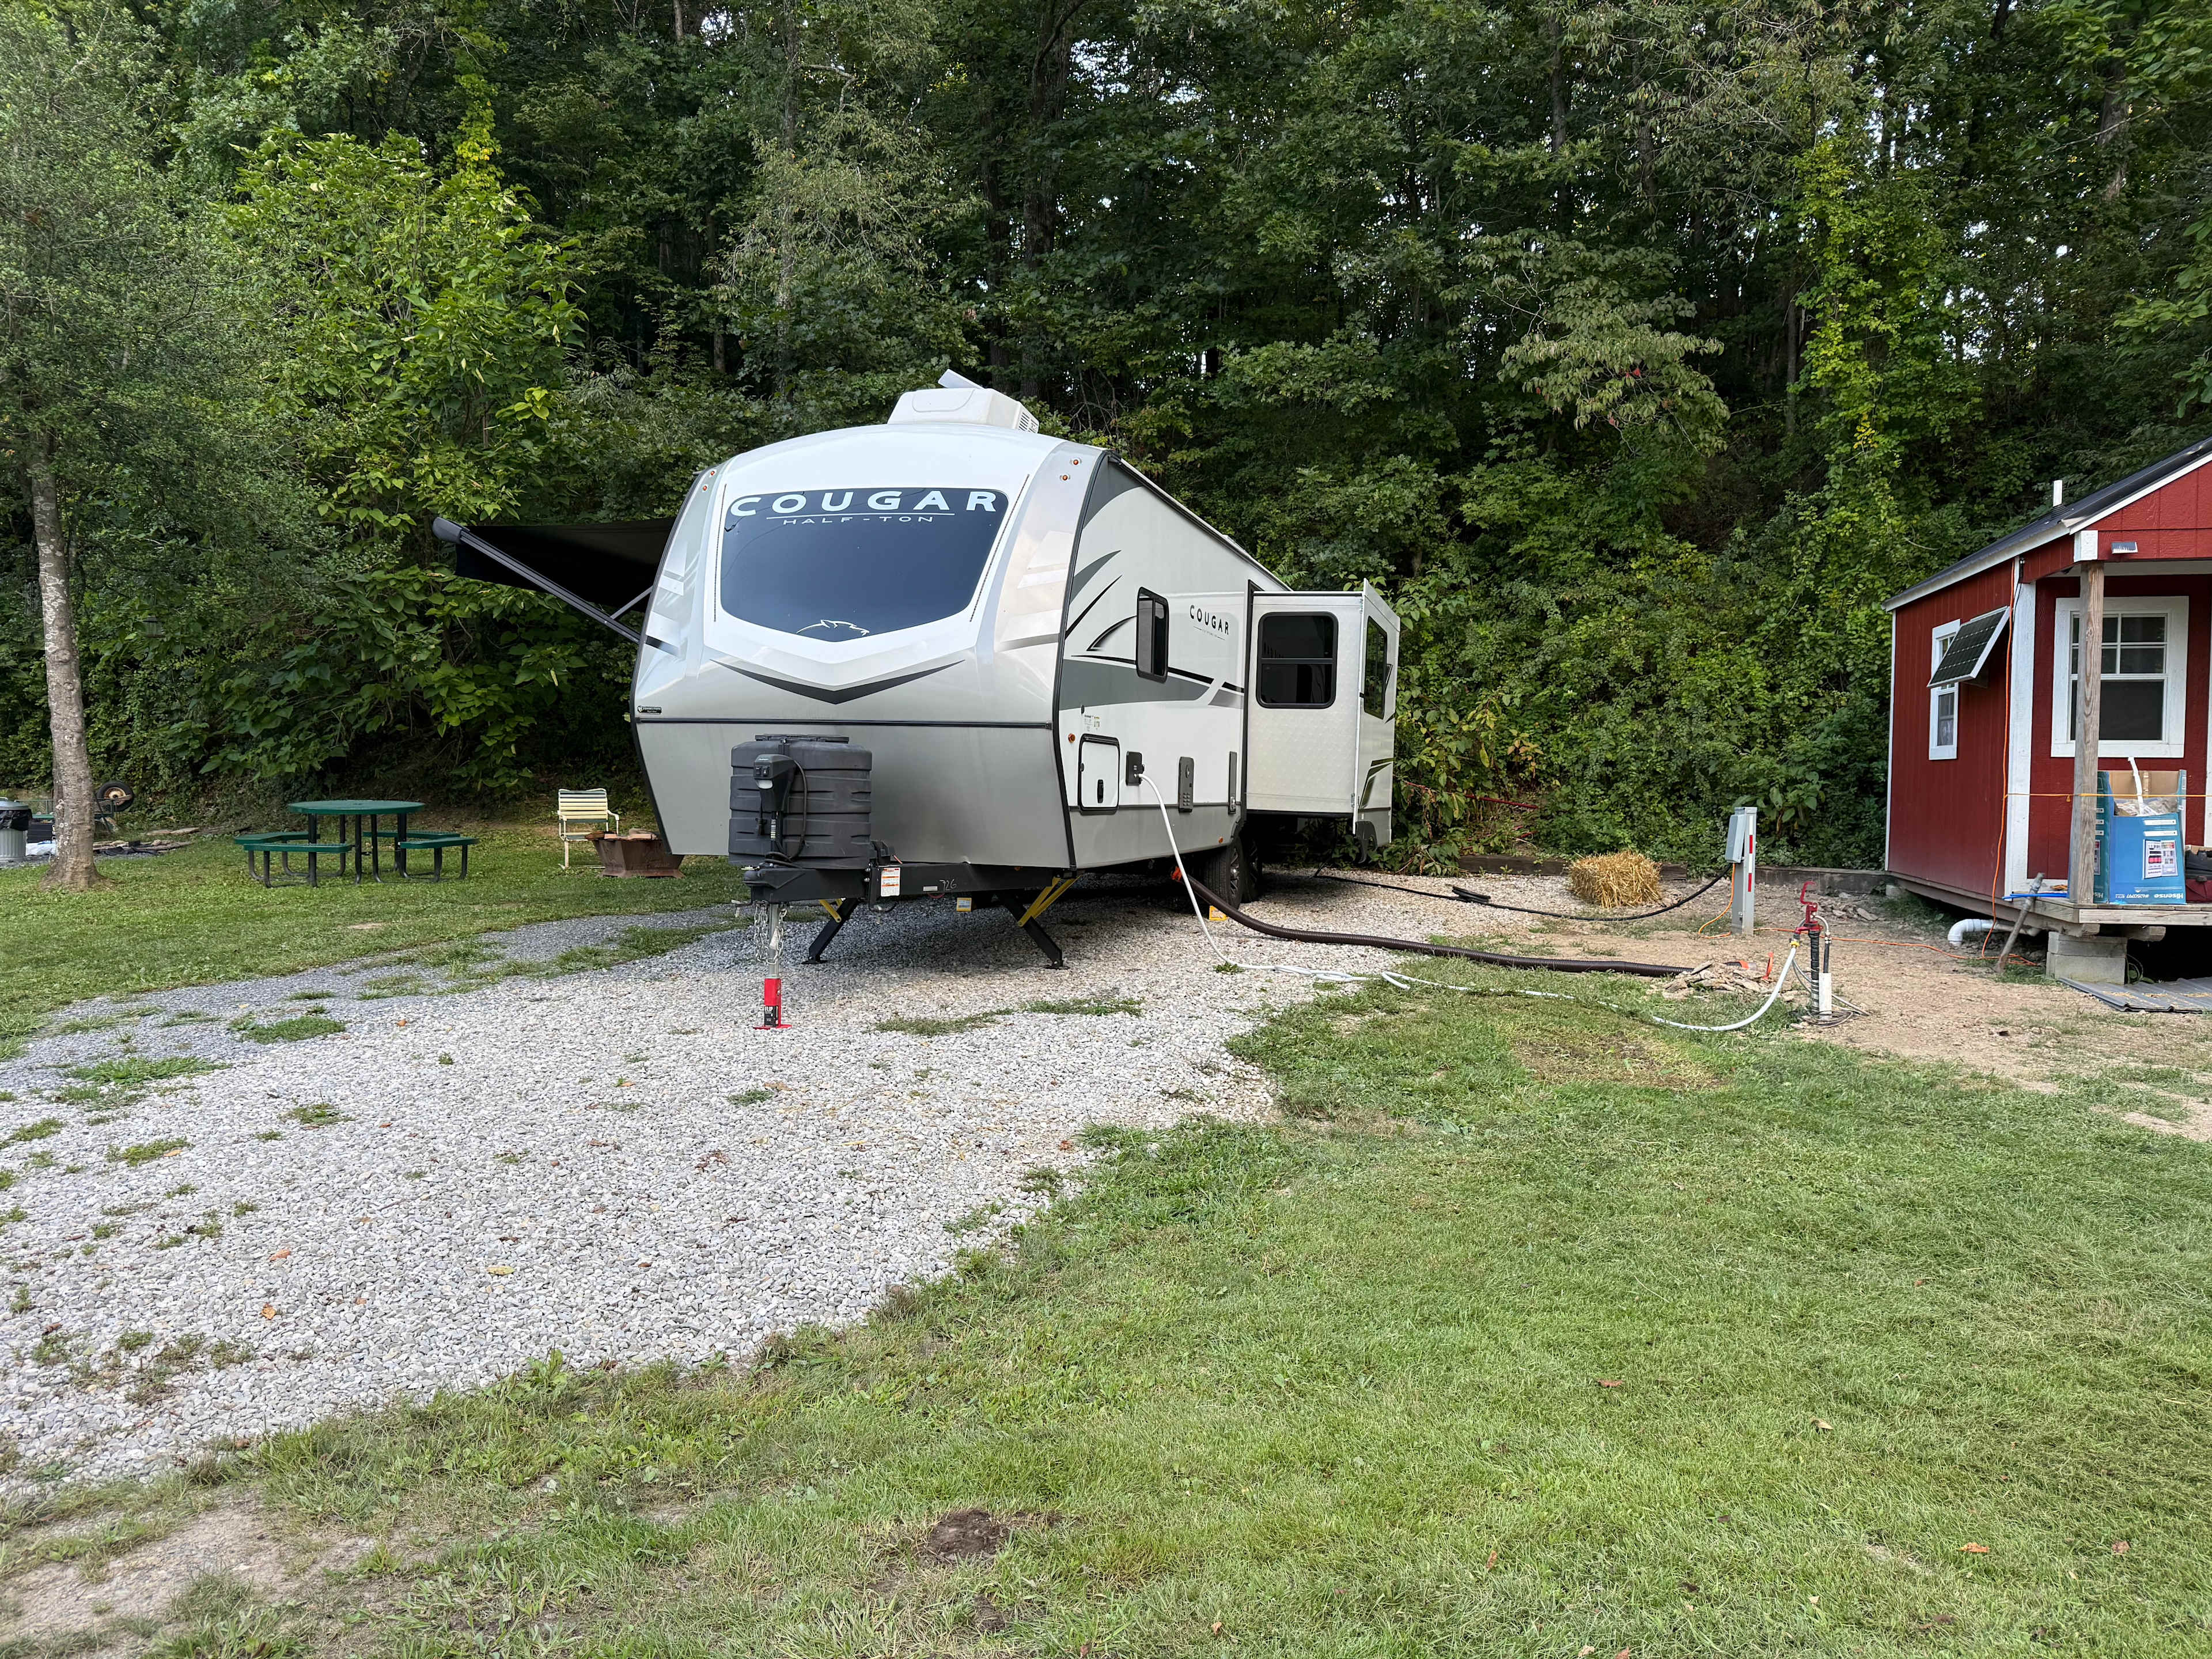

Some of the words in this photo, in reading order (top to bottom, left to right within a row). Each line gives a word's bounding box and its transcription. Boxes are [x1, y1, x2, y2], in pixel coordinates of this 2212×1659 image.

[730, 490, 997, 517] COUGAR
[1190, 604, 1229, 635] COUGAR
[940, 878, 957, 892] 726
